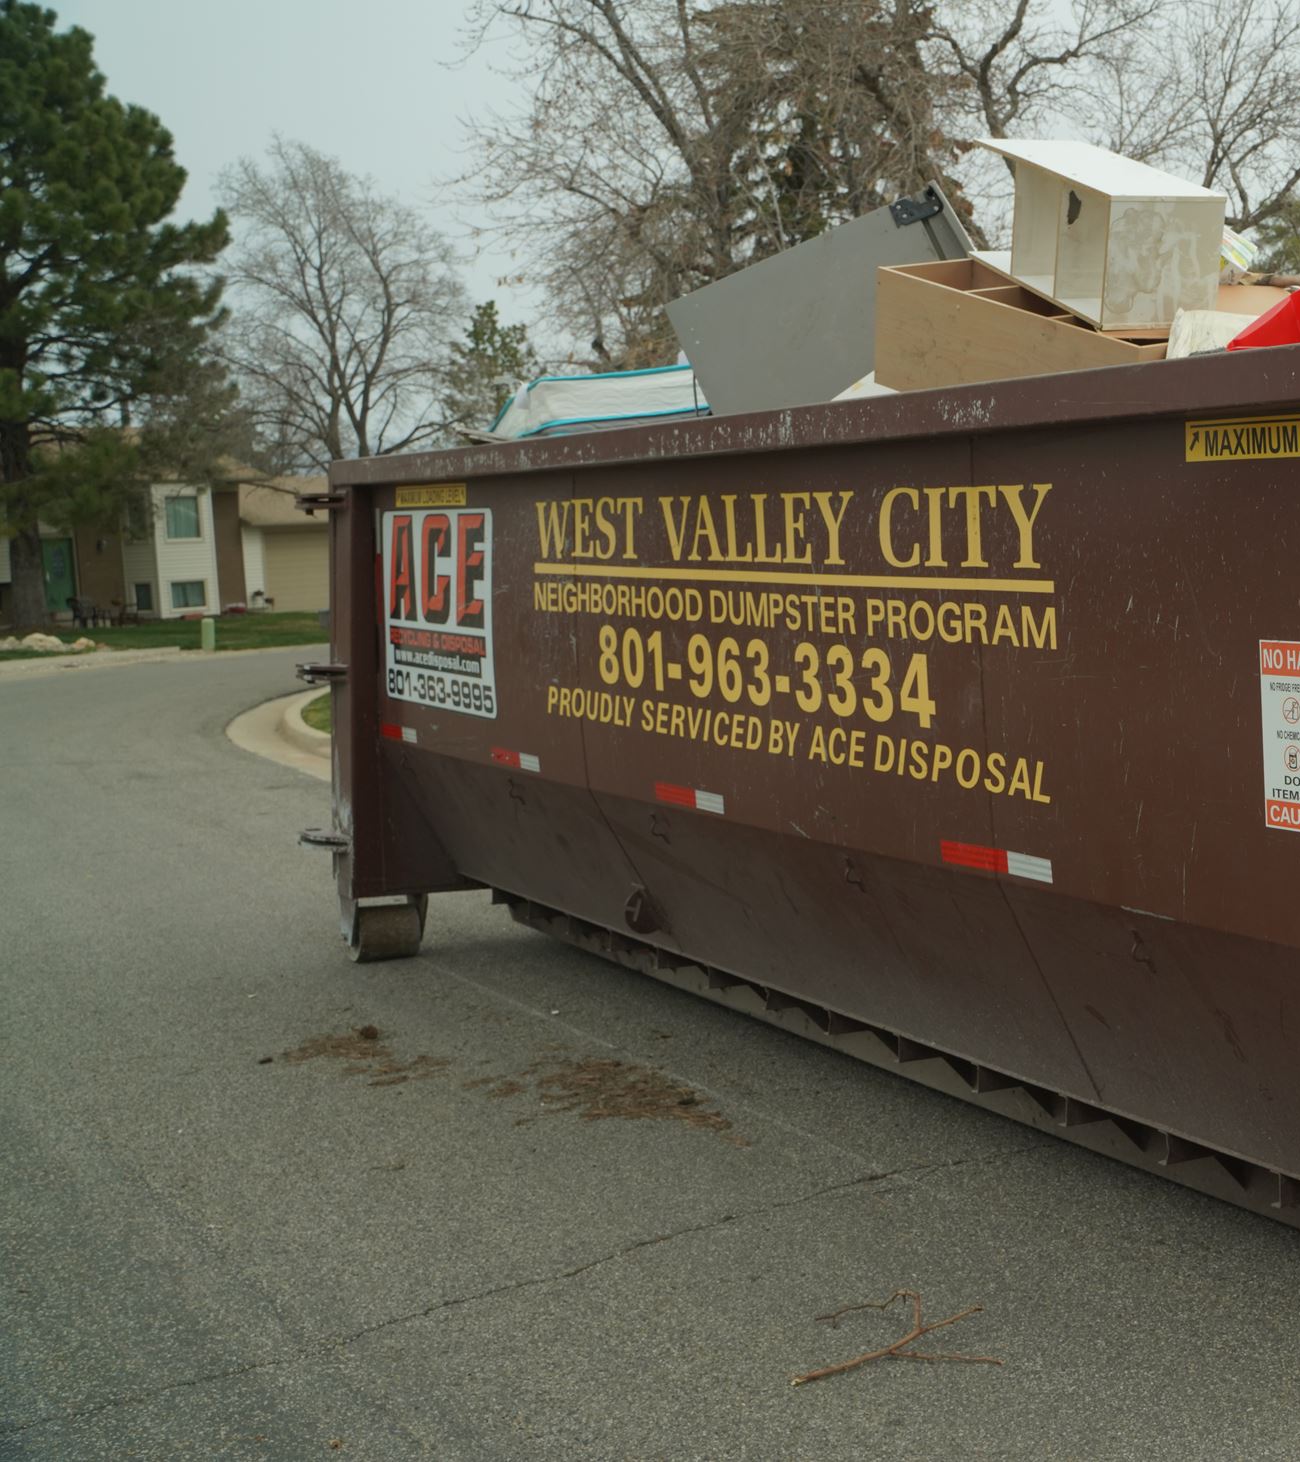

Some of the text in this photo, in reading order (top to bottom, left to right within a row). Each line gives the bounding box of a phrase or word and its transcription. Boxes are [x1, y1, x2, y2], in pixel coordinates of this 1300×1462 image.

[1204, 425, 1299, 457] MAXIMUM
[535, 483, 1053, 569] WEST VALLEY CITY
[390, 513, 485, 629] ACE
[534, 581, 1058, 650] NEIGHBORHOOD DUMPSTER PROGRAM
[395, 649, 480, 674] www.acedisposal.com
[598, 624, 937, 729] 801-963-3334
[1263, 648, 1284, 670] NO
[388, 668, 494, 714] 801-363-9995
[548, 686, 1051, 804] PROUDLY SERVICED BY ACE DISPOSAL
[1277, 730, 1283, 740] NO
[1285, 775, 1300, 787] DO
